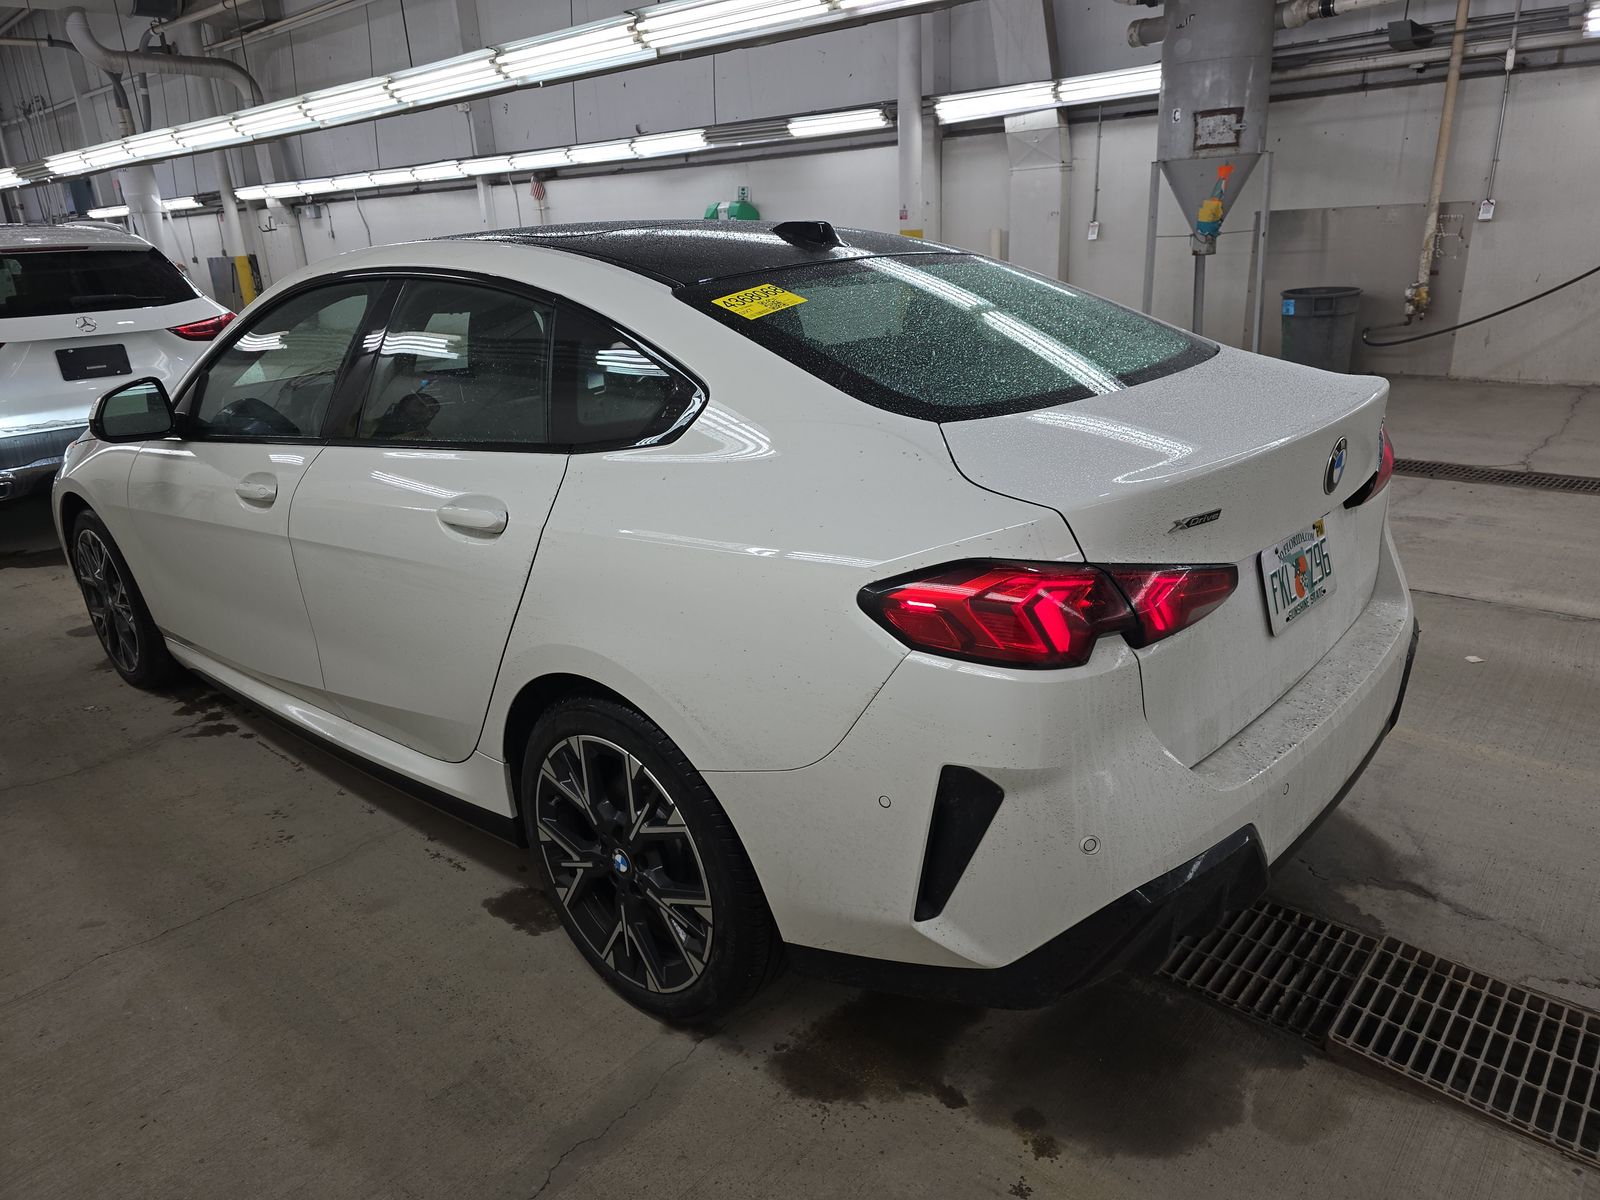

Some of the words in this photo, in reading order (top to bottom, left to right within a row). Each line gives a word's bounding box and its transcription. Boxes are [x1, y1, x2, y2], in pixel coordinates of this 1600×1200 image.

[1270, 564, 1298, 615] FKL
[1305, 537, 1332, 589] Z96
[1288, 597, 1309, 622] SUNSHINE
